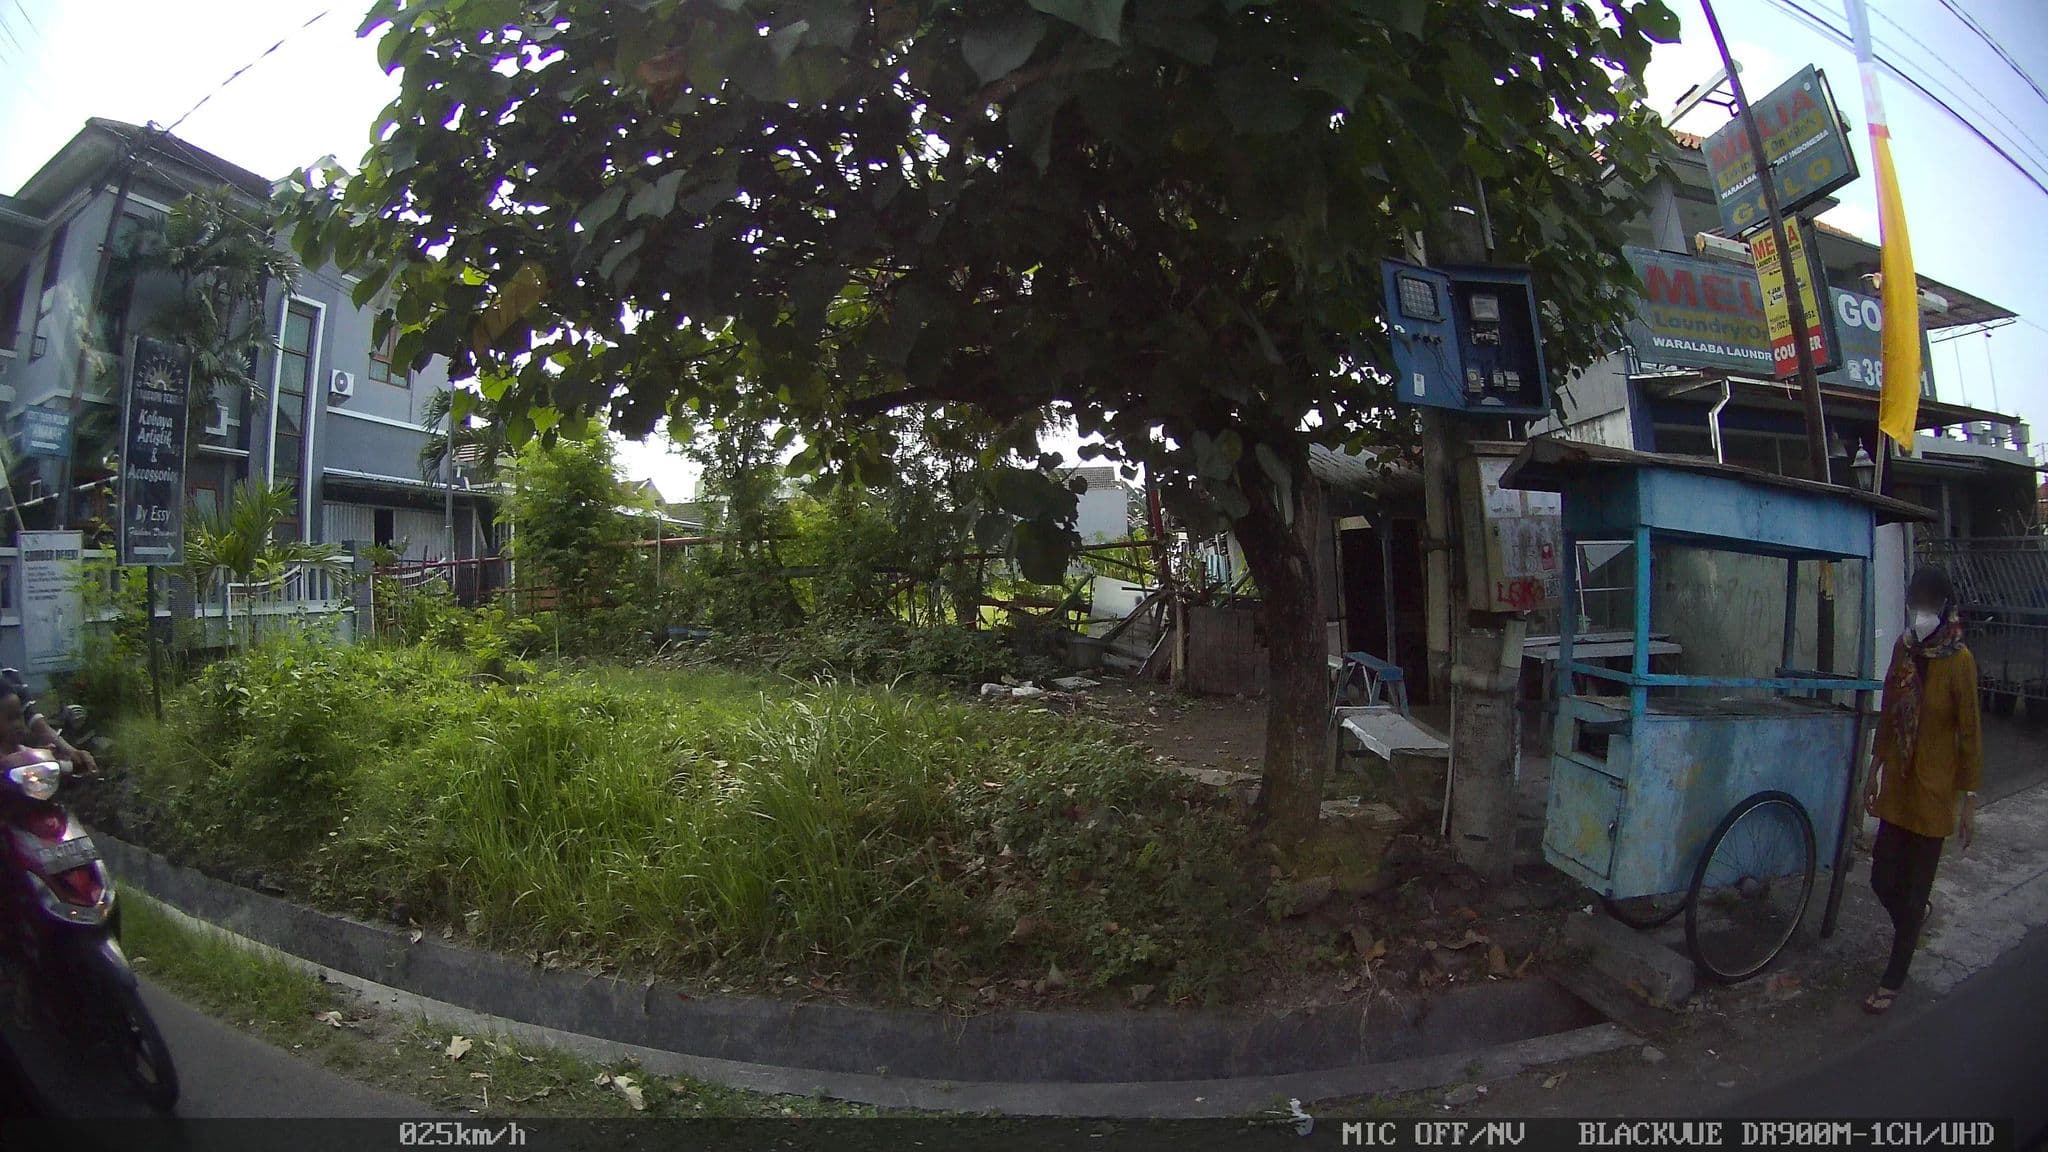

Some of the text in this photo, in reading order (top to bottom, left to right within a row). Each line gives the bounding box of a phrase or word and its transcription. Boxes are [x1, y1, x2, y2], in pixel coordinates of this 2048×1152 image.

[1721, 173, 1758, 199] WARALABA
[1652, 336, 1773, 362] WARALABA LAUNDR
[150, 505, 171, 523] Essy
